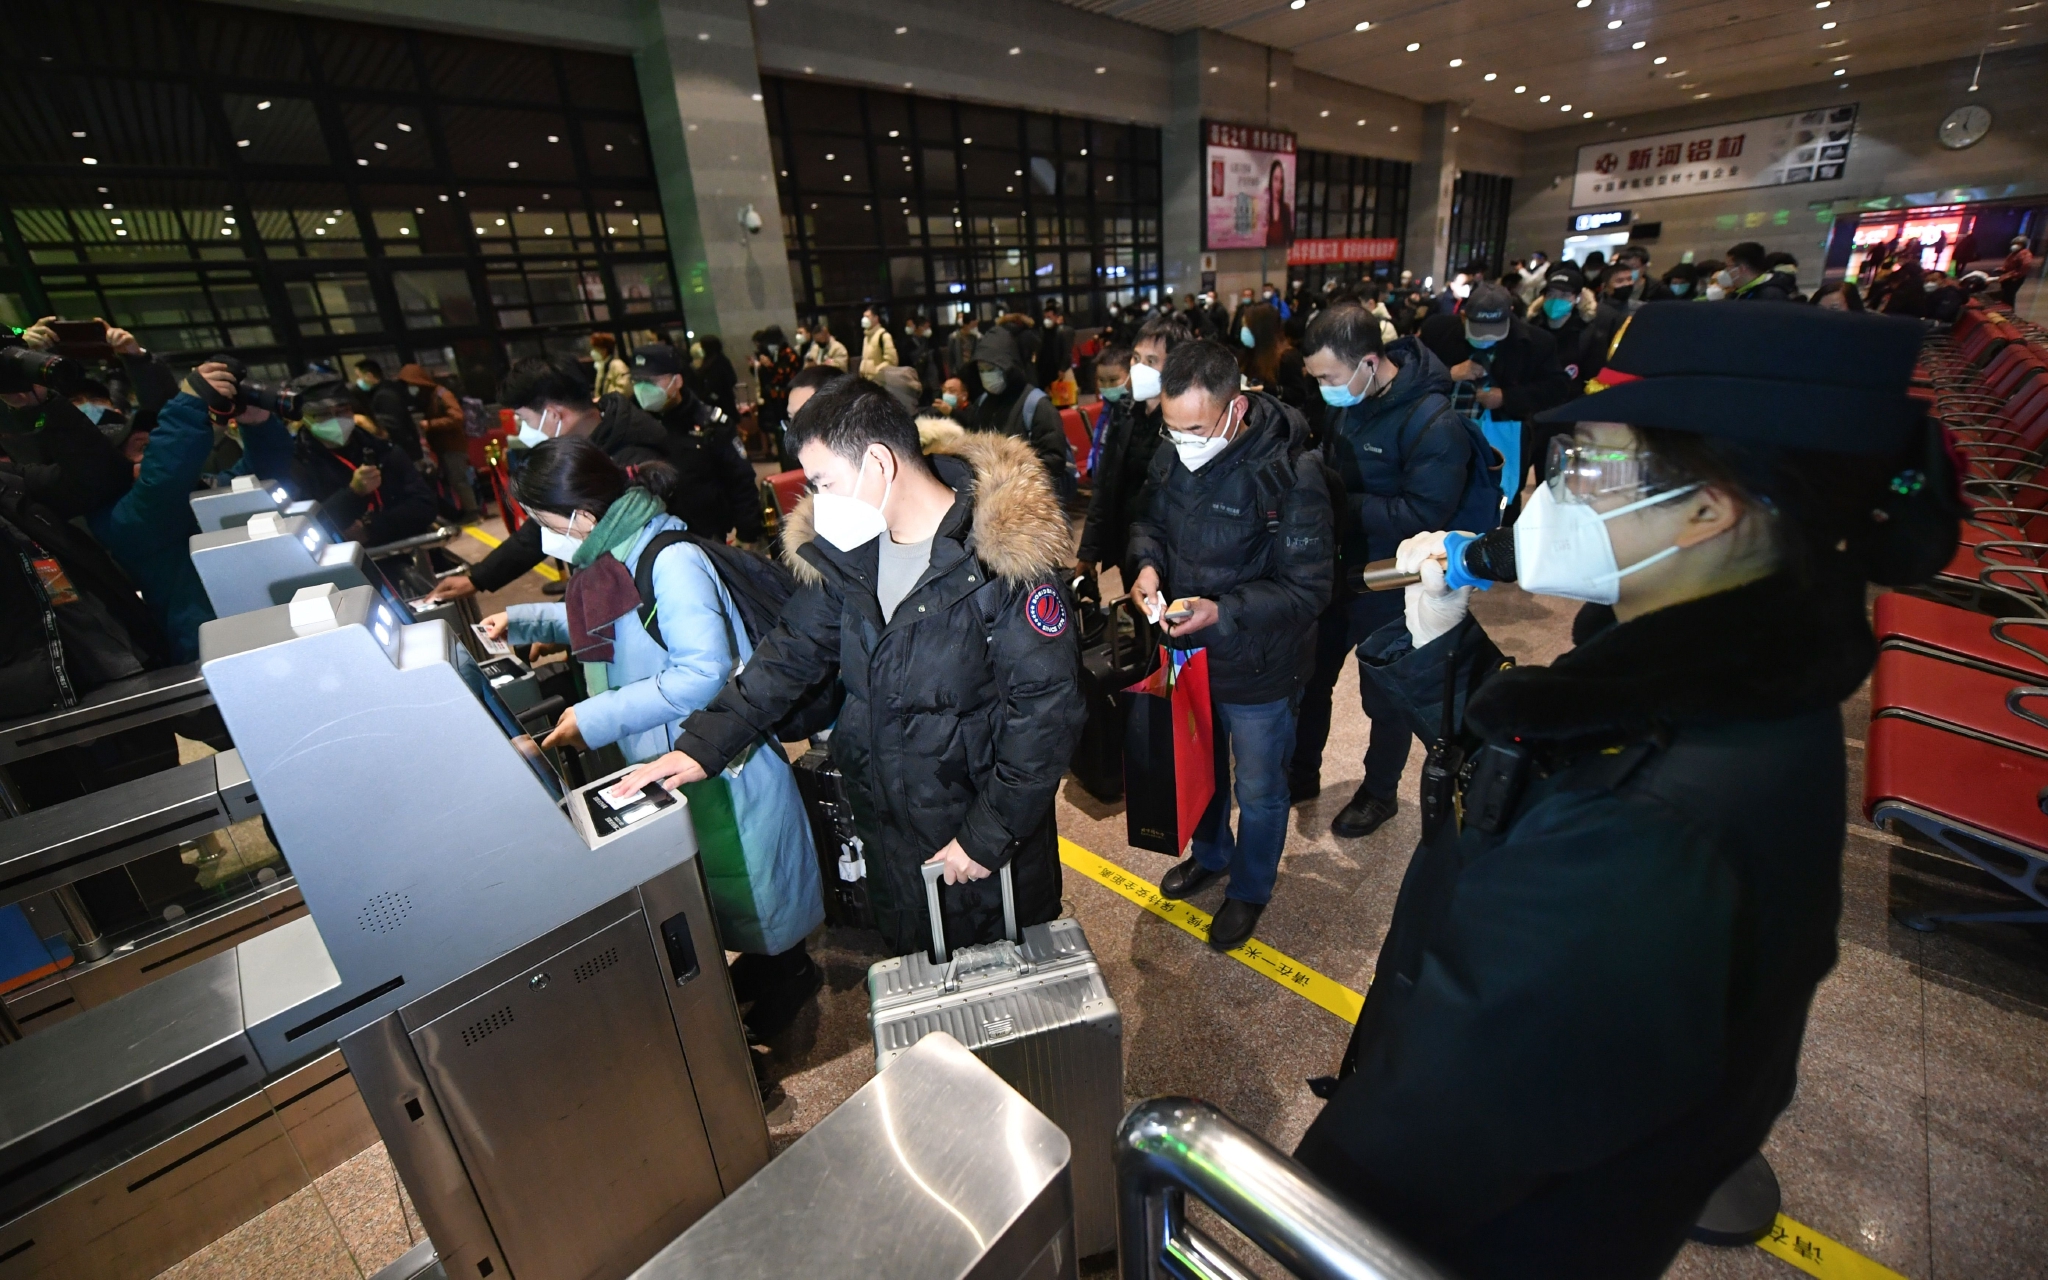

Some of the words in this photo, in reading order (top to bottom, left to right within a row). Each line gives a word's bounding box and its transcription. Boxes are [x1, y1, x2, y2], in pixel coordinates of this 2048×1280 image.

[1628, 134, 1745, 171] 新河铝材
[19, 552, 33, 575] EVEREST
[55, 665, 68, 689] EVEREST
